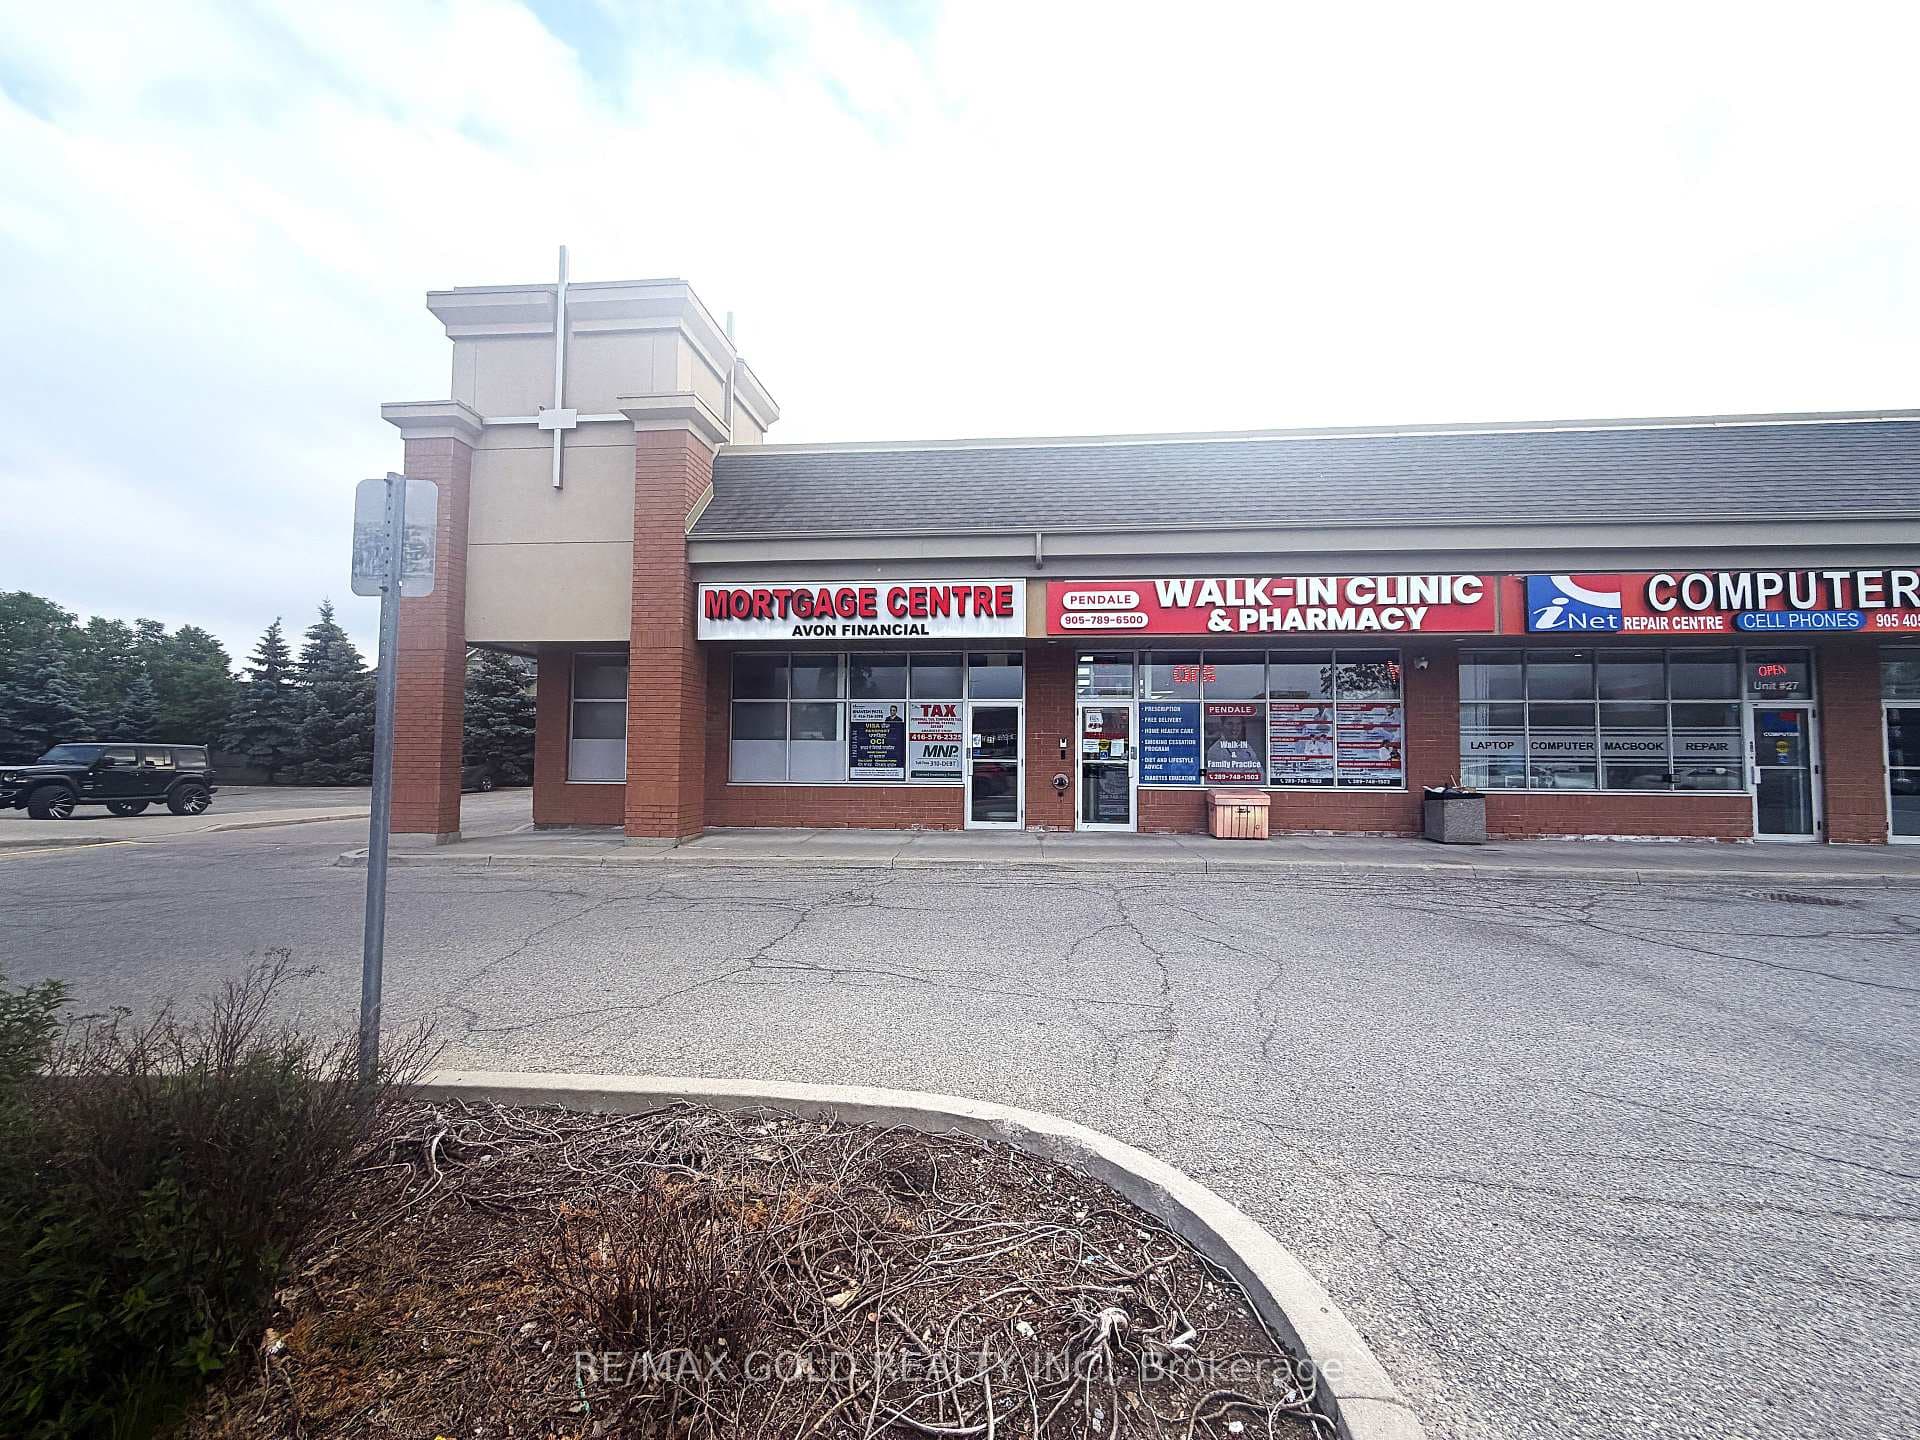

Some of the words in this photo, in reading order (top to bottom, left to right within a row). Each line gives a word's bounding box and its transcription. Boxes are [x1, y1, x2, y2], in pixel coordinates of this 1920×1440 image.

[1154, 576, 1343, 607] WALK-IN
[1345, 575, 1484, 605] CLINIC
[704, 588, 878, 620] MORTGAGE
[886, 585, 1014, 617] CENTRE
[1069, 594, 1132, 606] PENDALE
[1064, 615, 1144, 626] 905-789-6500
[1207, 609, 1234, 632] &
[1238, 607, 1428, 632] PHARMACY
[1623, 615, 1670, 630] REPAIR
[1672, 614, 1724, 629] CENTRE
[1743, 613, 1786, 629] CELL
[1788, 612, 1860, 628] PHONES
[1876, 613, 1899, 628] 905
[792, 624, 838, 637] AVON
[841, 623, 930, 637] FINANCIAL
[1758, 664, 1787, 677] OPEN
[1753, 681, 1777, 690] Unit
[920, 704, 957, 717] TAX
[923, 745, 959, 757] MNP
[1470, 741, 1515, 750] LAPTOP
[1530, 741, 1595, 751] COMPUTER
[1604, 742, 1665, 751] MACBOOK
[1685, 742, 1729, 751] REPAIR
[1207, 760, 1231, 769] Family
[1231, 760, 1262, 768] Practice
